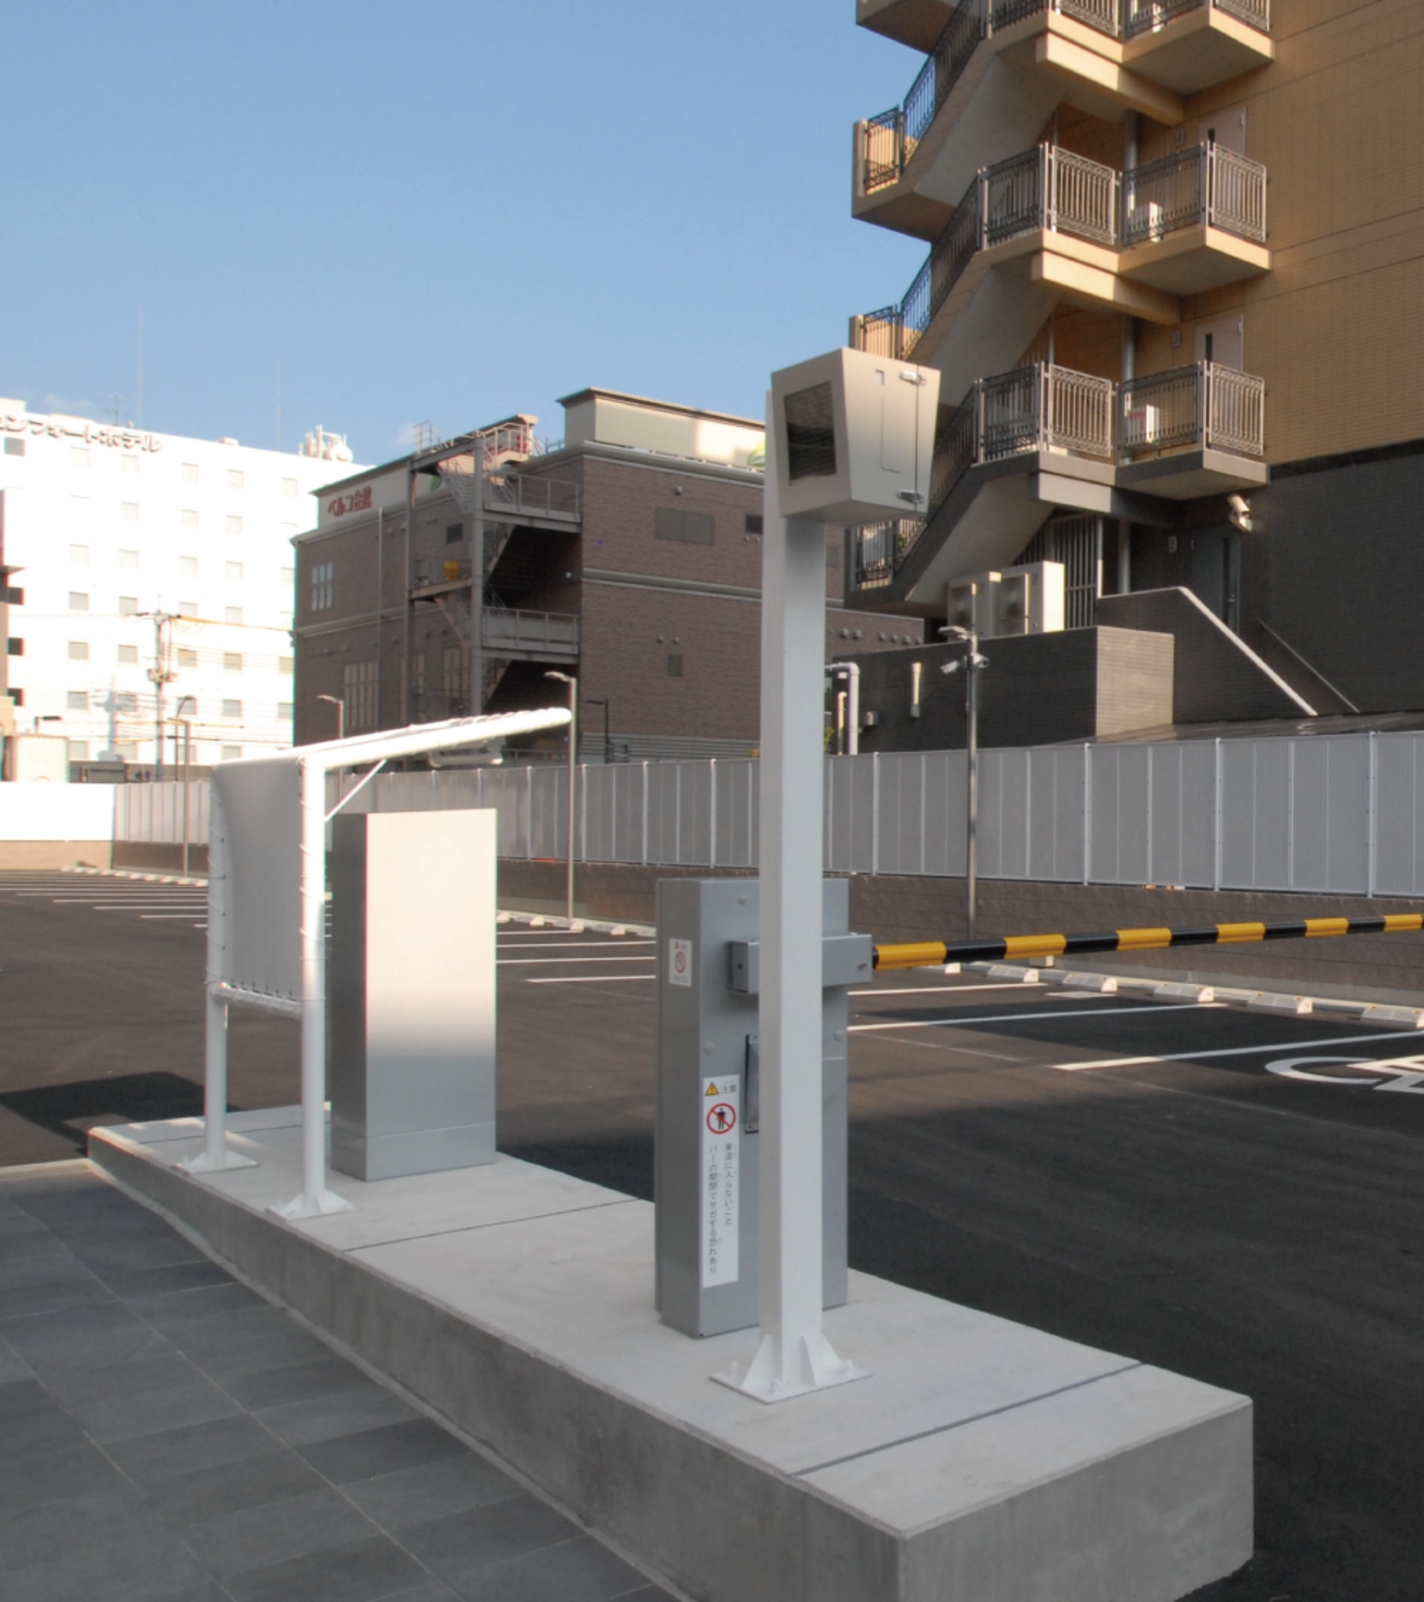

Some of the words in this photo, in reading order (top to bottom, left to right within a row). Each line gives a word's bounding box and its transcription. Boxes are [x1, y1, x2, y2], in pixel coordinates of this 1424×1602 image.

[0, 416, 163, 453] ンフォートホテル
